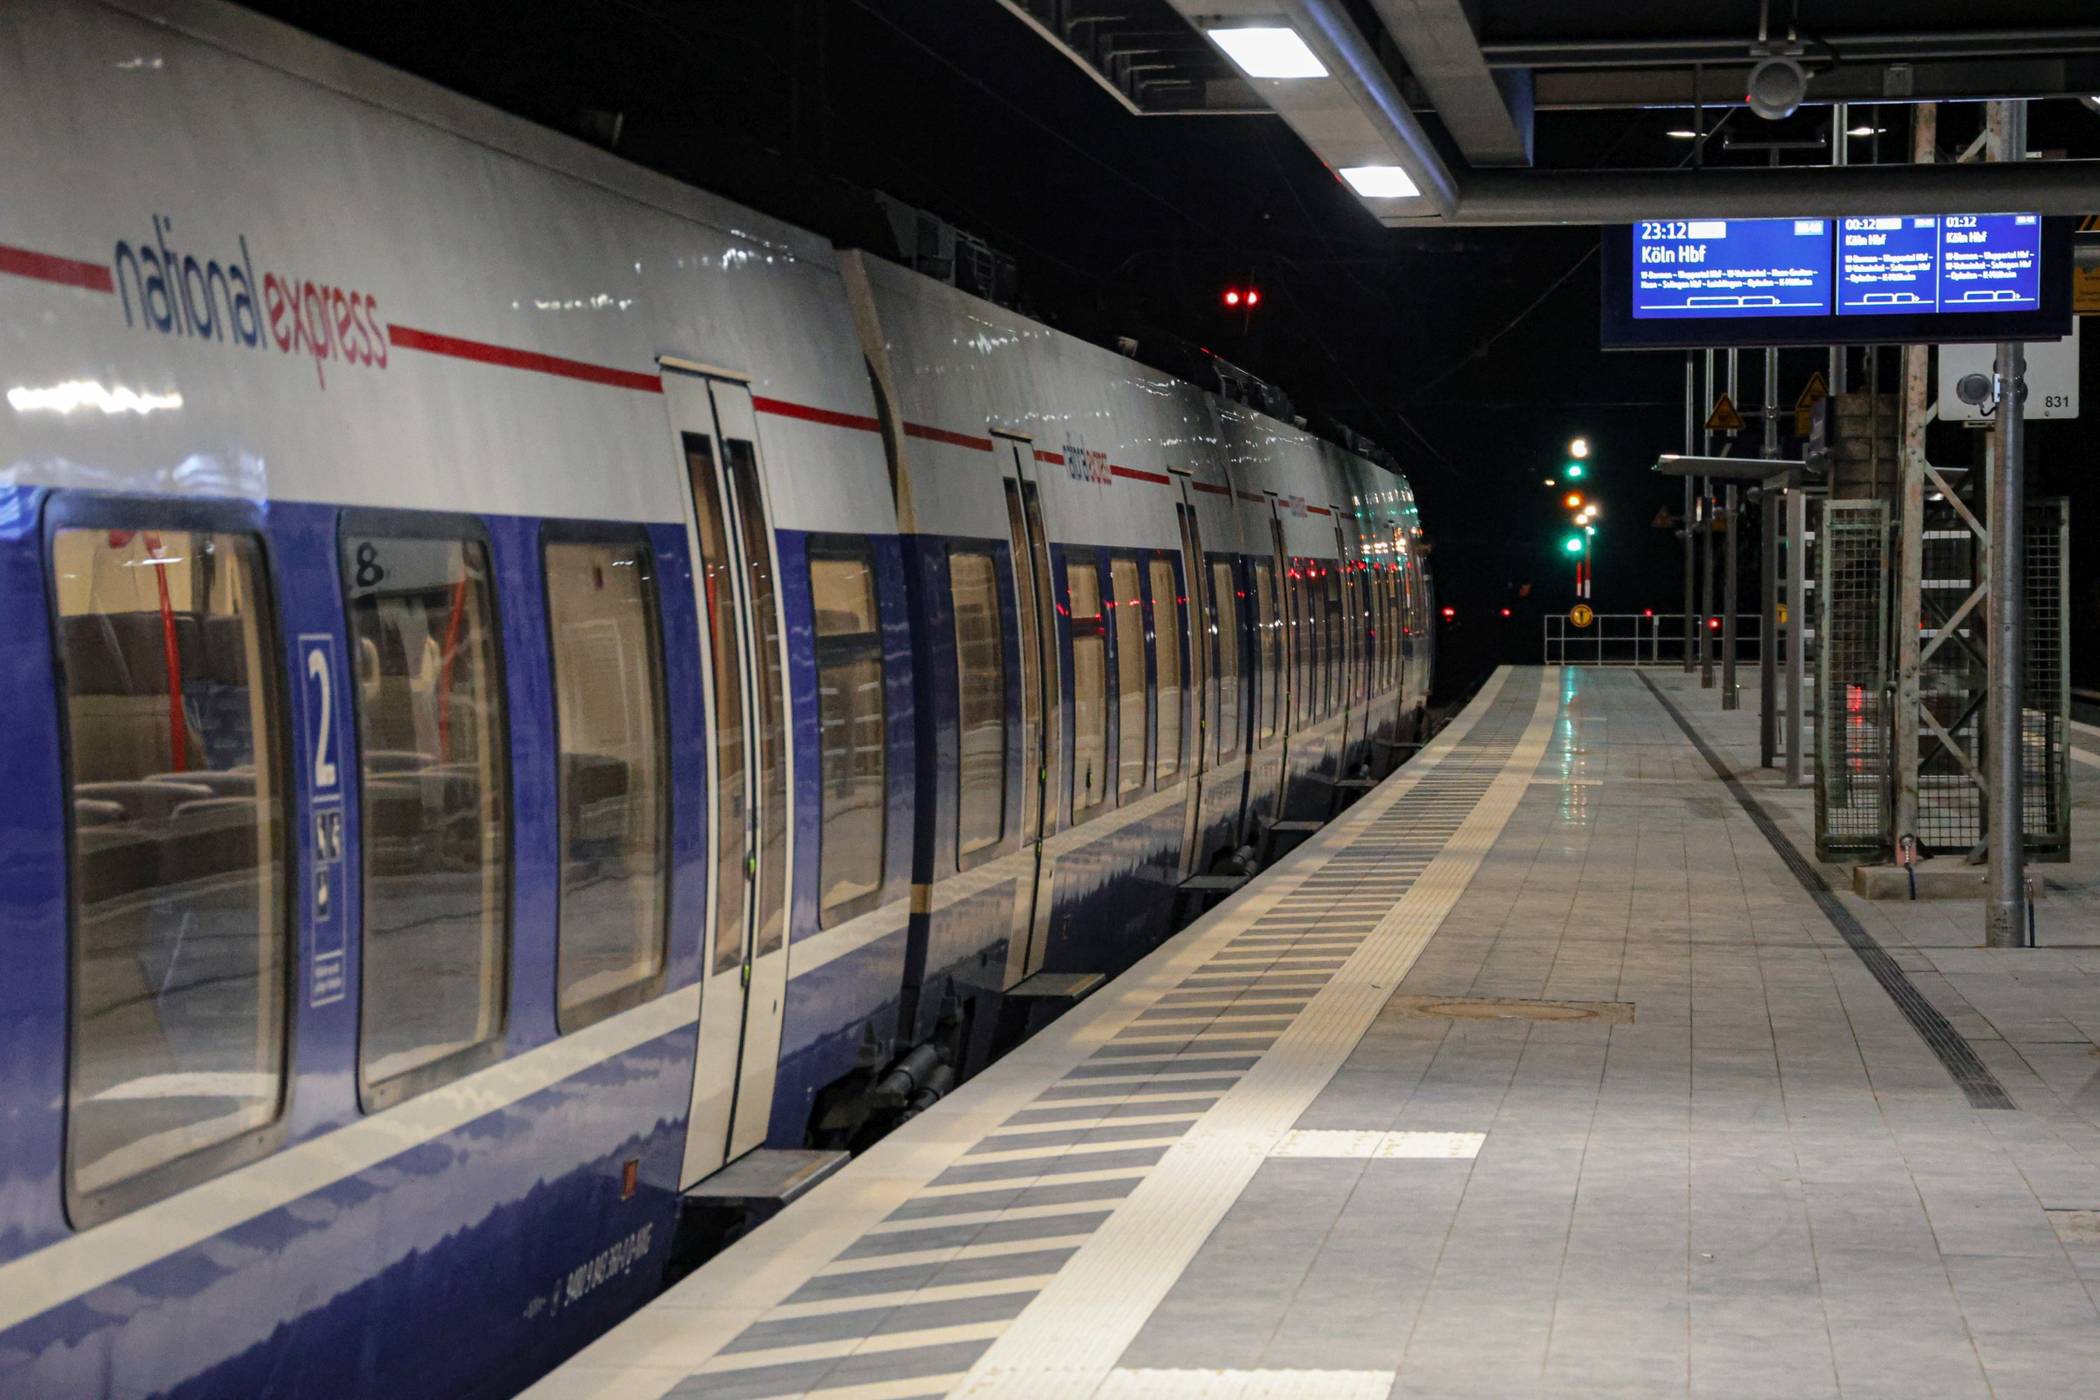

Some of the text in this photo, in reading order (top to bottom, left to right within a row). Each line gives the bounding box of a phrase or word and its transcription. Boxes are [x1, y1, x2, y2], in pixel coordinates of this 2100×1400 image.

[1641, 222, 1687, 240] 23:12
[1845, 218, 1876, 231] 00:12
[1946, 216, 1977, 228] 01:12
[1641, 245, 1707, 263] Köln Hbf
[115, 213, 388, 391] national express
[2045, 396, 2070, 408] 831
[356, 541, 384, 588] 8
[308, 648, 337, 787] 2
